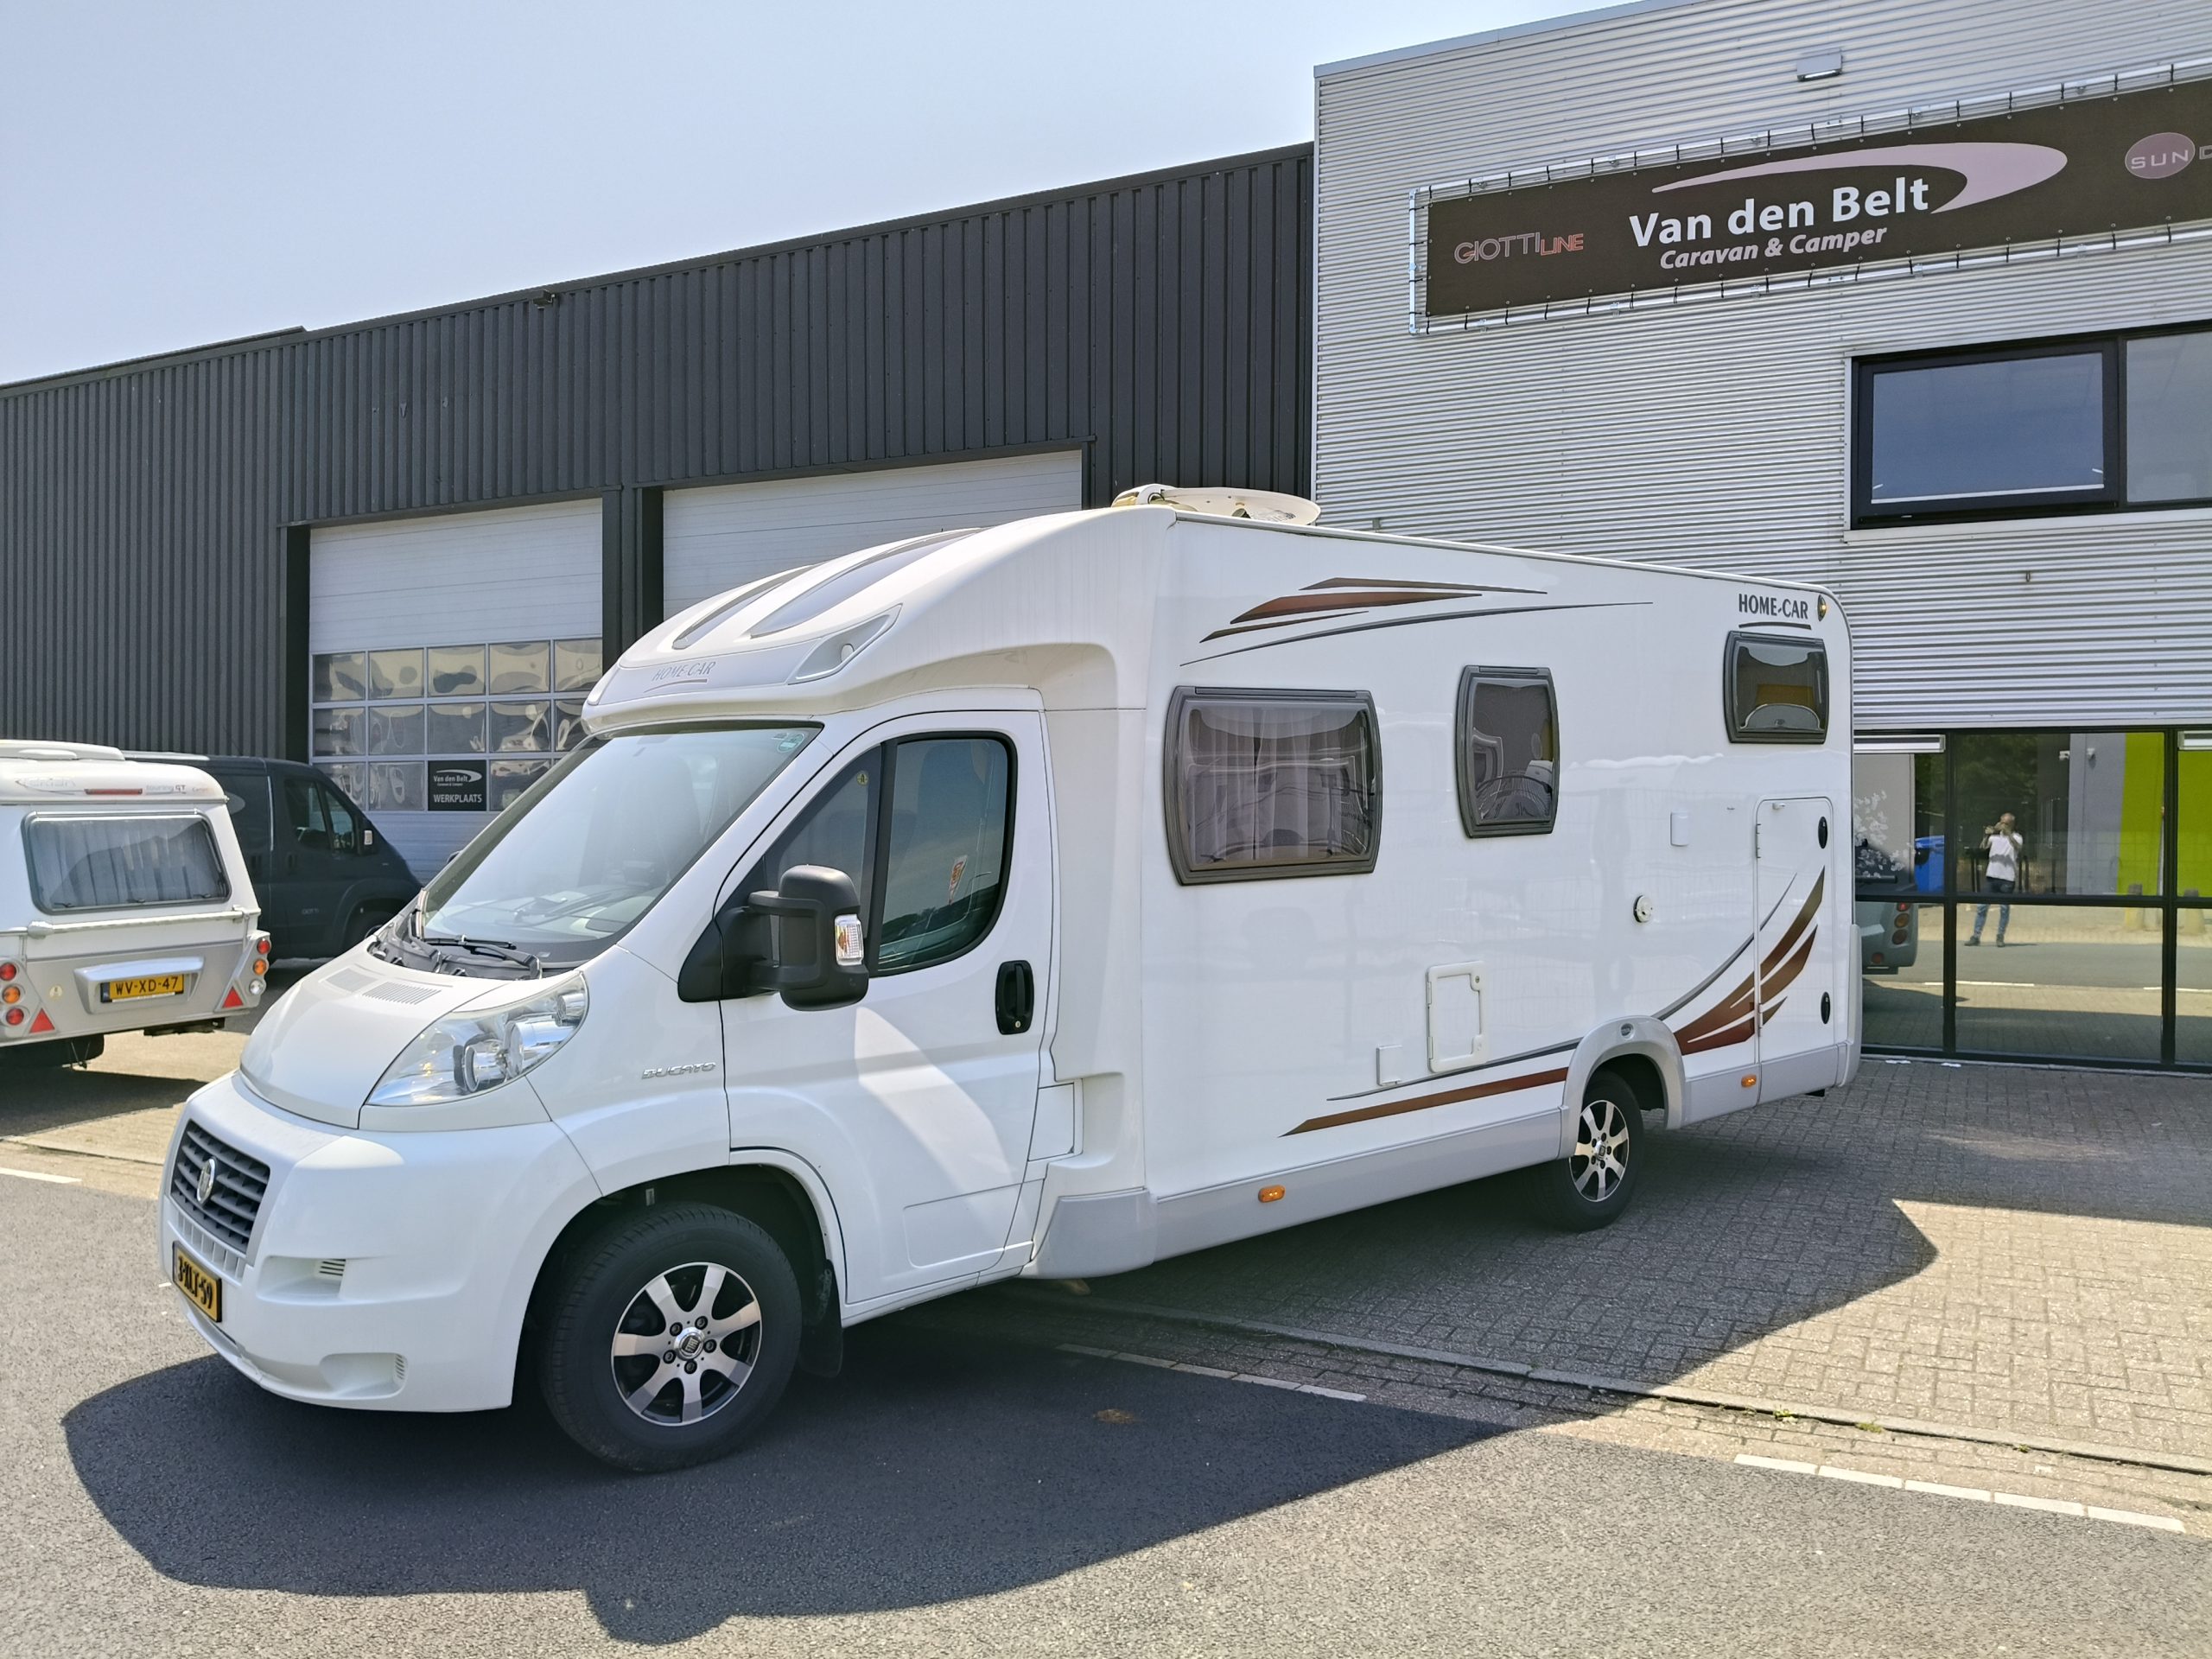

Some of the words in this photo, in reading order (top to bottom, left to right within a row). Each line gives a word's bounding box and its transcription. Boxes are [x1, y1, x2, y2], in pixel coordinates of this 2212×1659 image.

[2131, 149, 2189, 169] SUN
[1629, 213, 1712, 247] Van
[1728, 198, 1814, 235] den
[1834, 177, 1929, 222] Belt
[1454, 232, 1584, 264] GIOTTILINE
[1660, 245, 1758, 270] Caravan
[1764, 238, 1783, 257] &
[1789, 227, 1887, 254] Camper
[1738, 593, 1808, 620] HOME-CAR
[433, 793, 482, 803] WERKPLAATS
[115, 976, 179, 995] WV-XD-47
[641, 1062, 716, 1079] DUCATO
